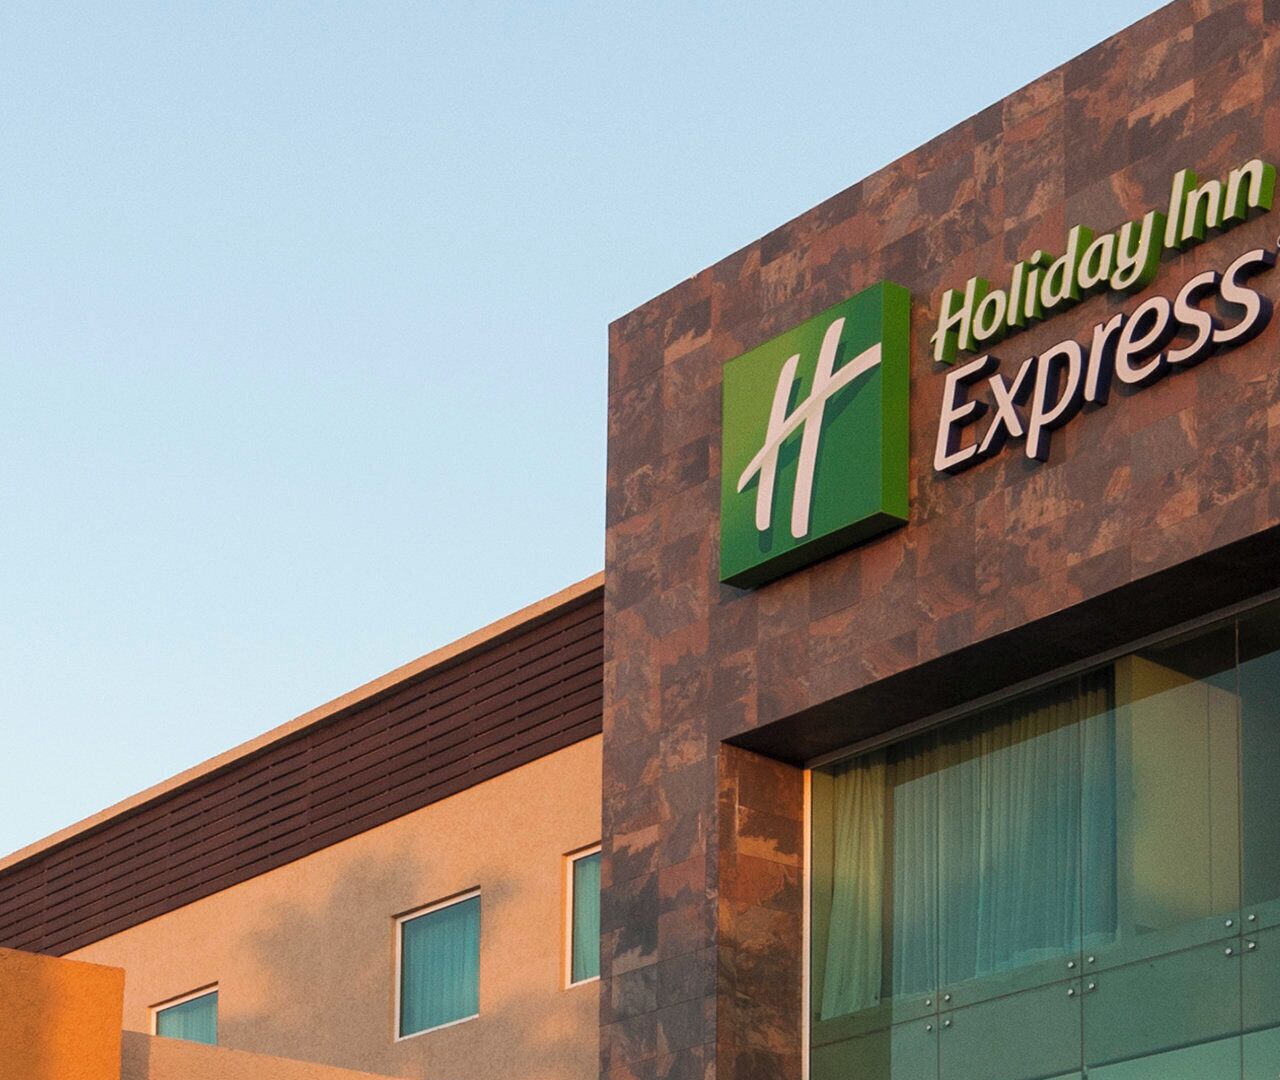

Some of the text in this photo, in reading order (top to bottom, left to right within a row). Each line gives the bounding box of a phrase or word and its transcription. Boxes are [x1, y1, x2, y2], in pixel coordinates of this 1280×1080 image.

[930, 158, 1277, 366] Holiday Inn
[933, 248, 1276, 473] Express
